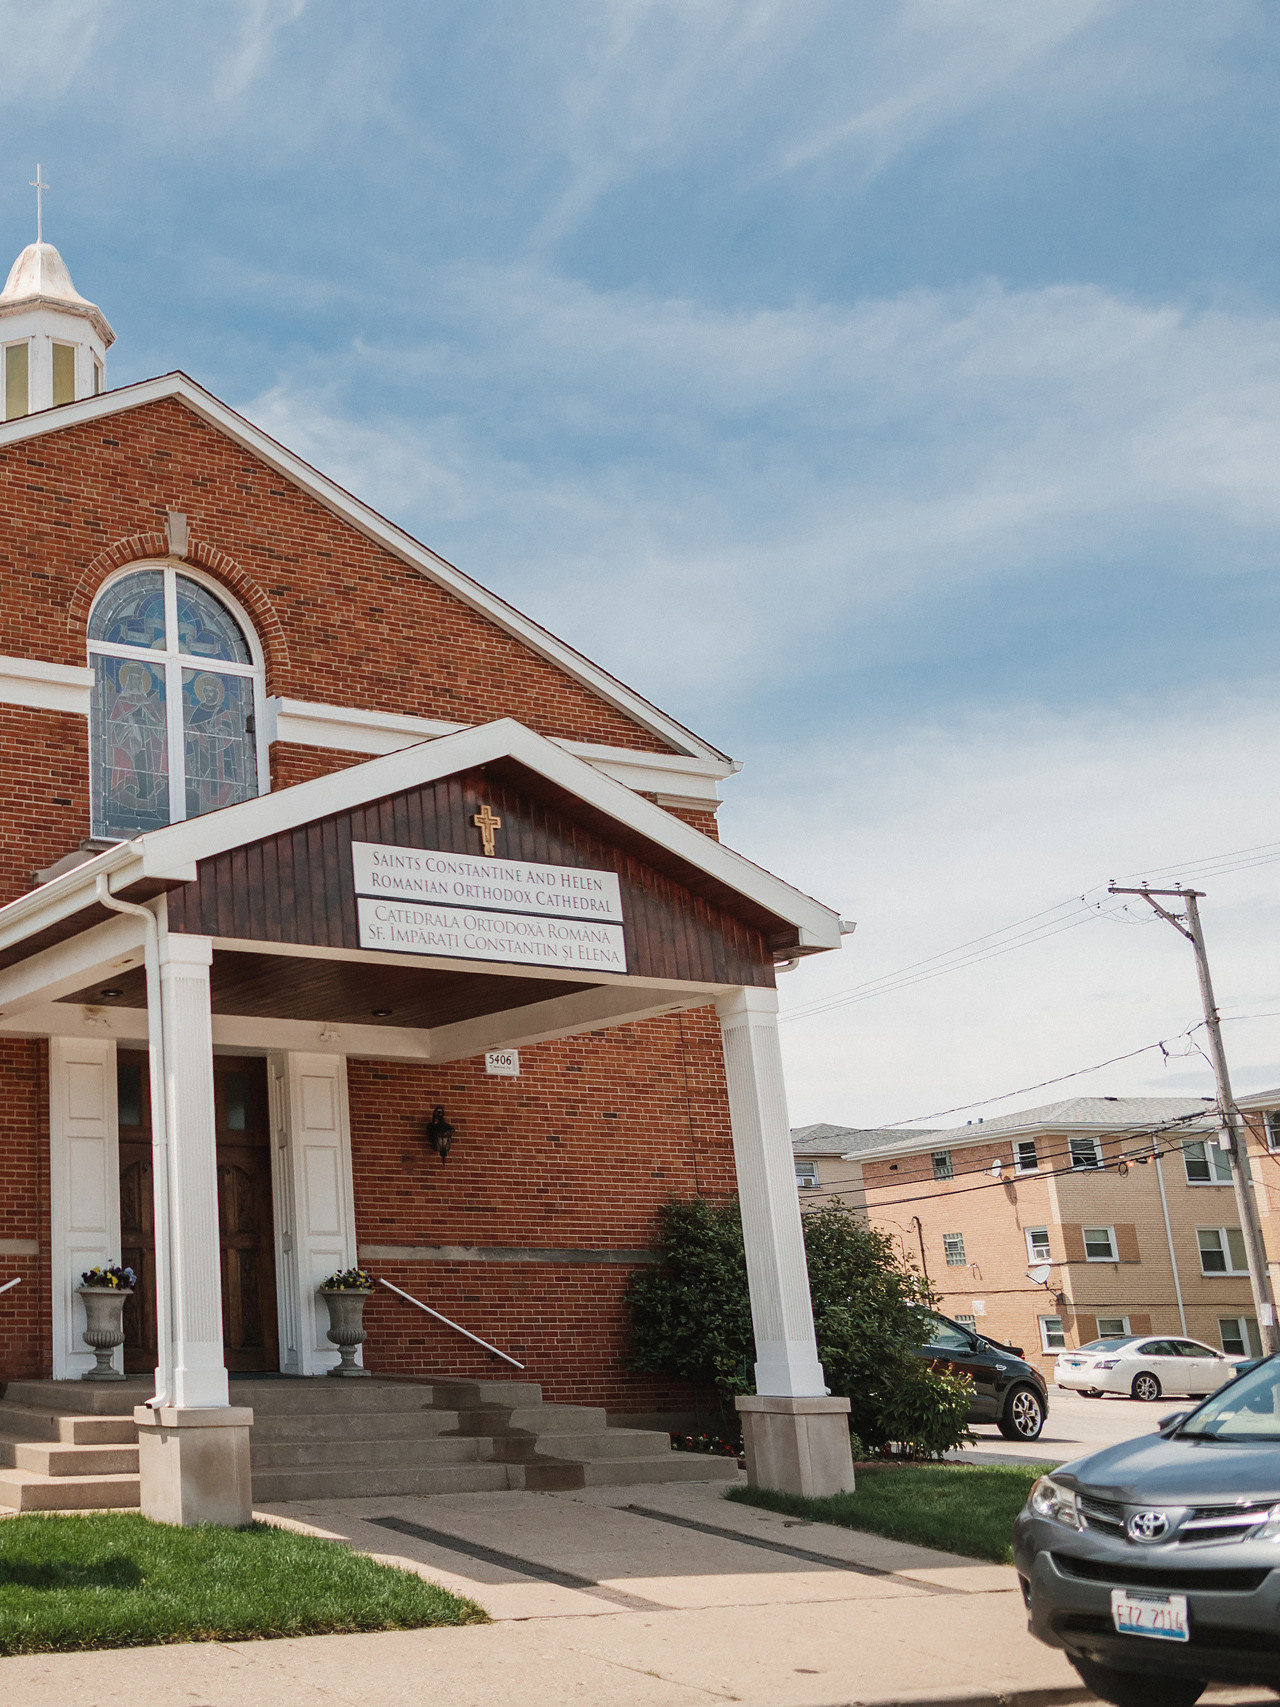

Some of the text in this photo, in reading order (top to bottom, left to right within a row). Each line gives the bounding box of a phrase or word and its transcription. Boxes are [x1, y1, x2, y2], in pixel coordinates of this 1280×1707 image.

[373, 851, 602, 891] SAINTS CONSTANTINE AND HELEN
[371, 872, 612, 912] ROMANIAN ORTHODOX CATHEDRAL
[375, 905, 460, 929] CATEDRALA
[368, 923, 386, 940] SF.
[463, 933, 558, 957] CONSTANTIN
[578, 944, 620, 963] ELENA
[489, 1054, 512, 1065] 5406
